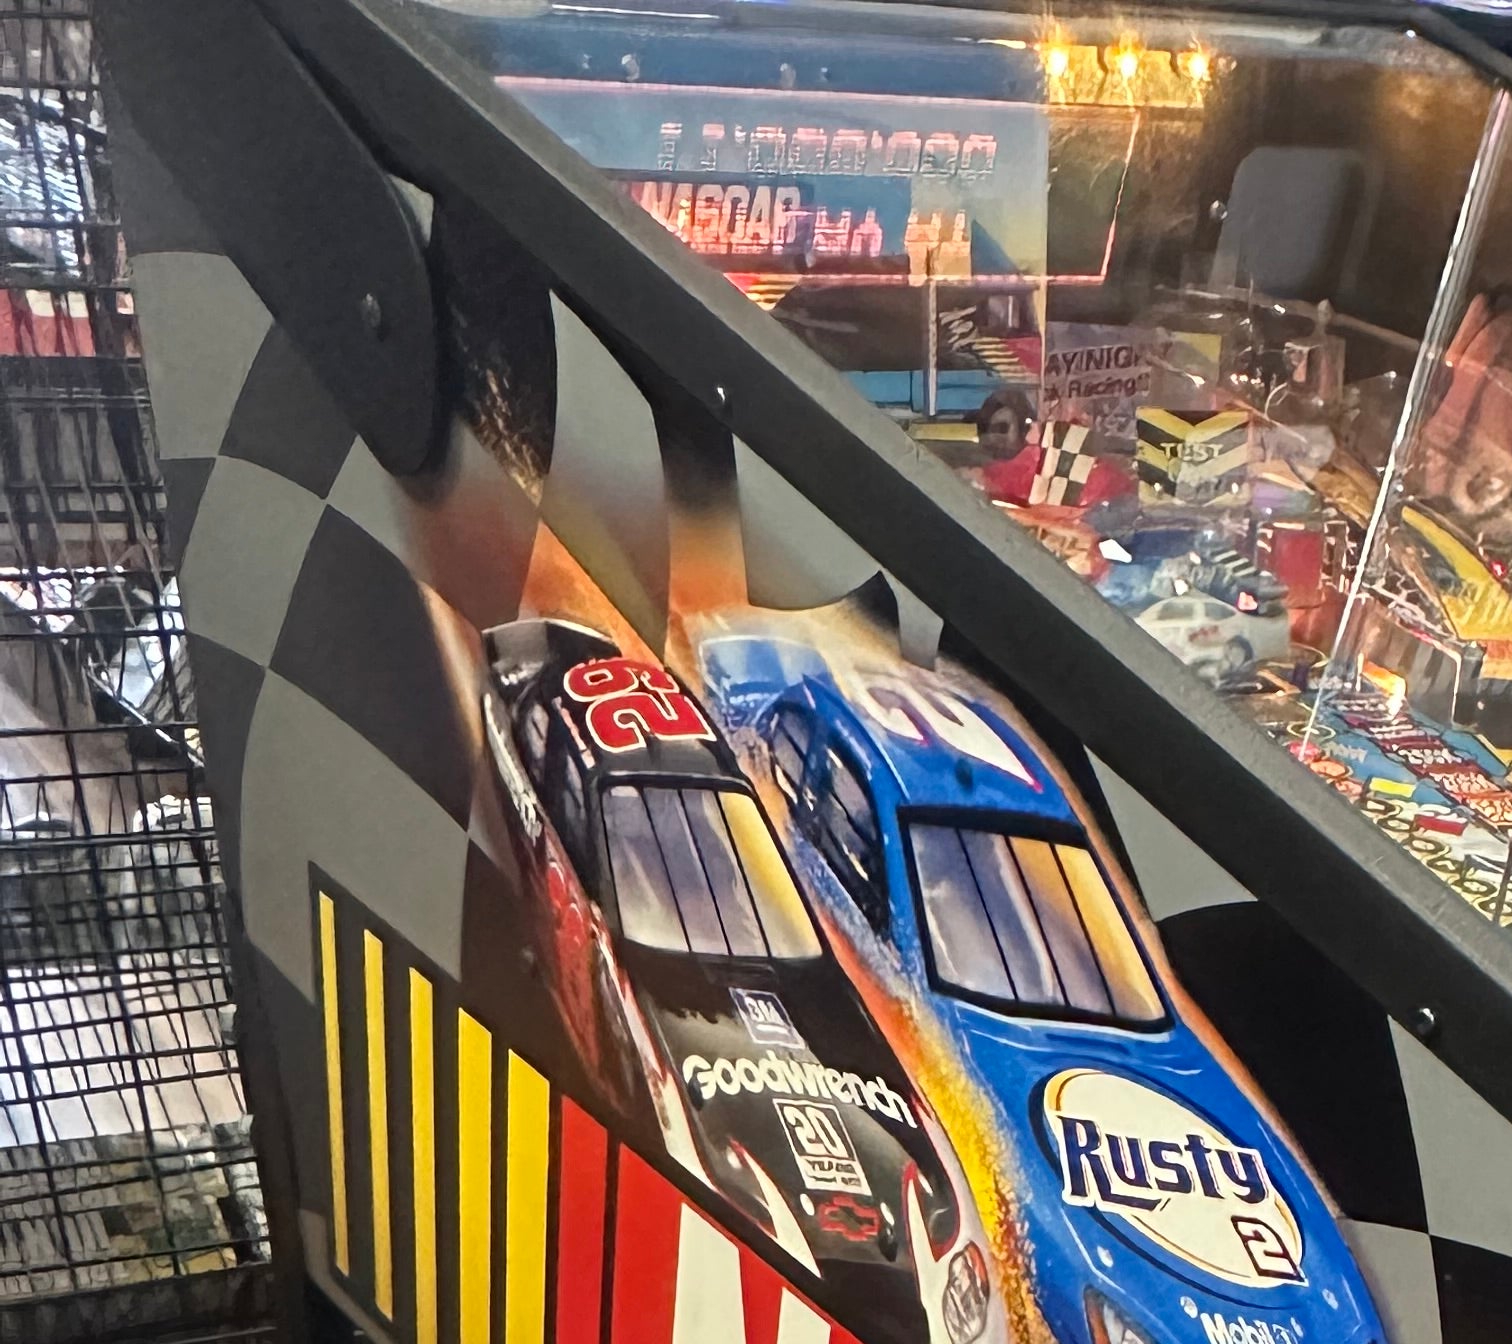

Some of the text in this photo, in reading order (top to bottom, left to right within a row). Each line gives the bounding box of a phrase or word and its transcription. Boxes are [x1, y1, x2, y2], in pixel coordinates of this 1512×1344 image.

[683, 1050, 917, 1128] Goodwrench
[783, 1105, 848, 1159] 20
[1056, 1115, 1268, 1212] Rusty
[1231, 1214, 1305, 1283] 2
